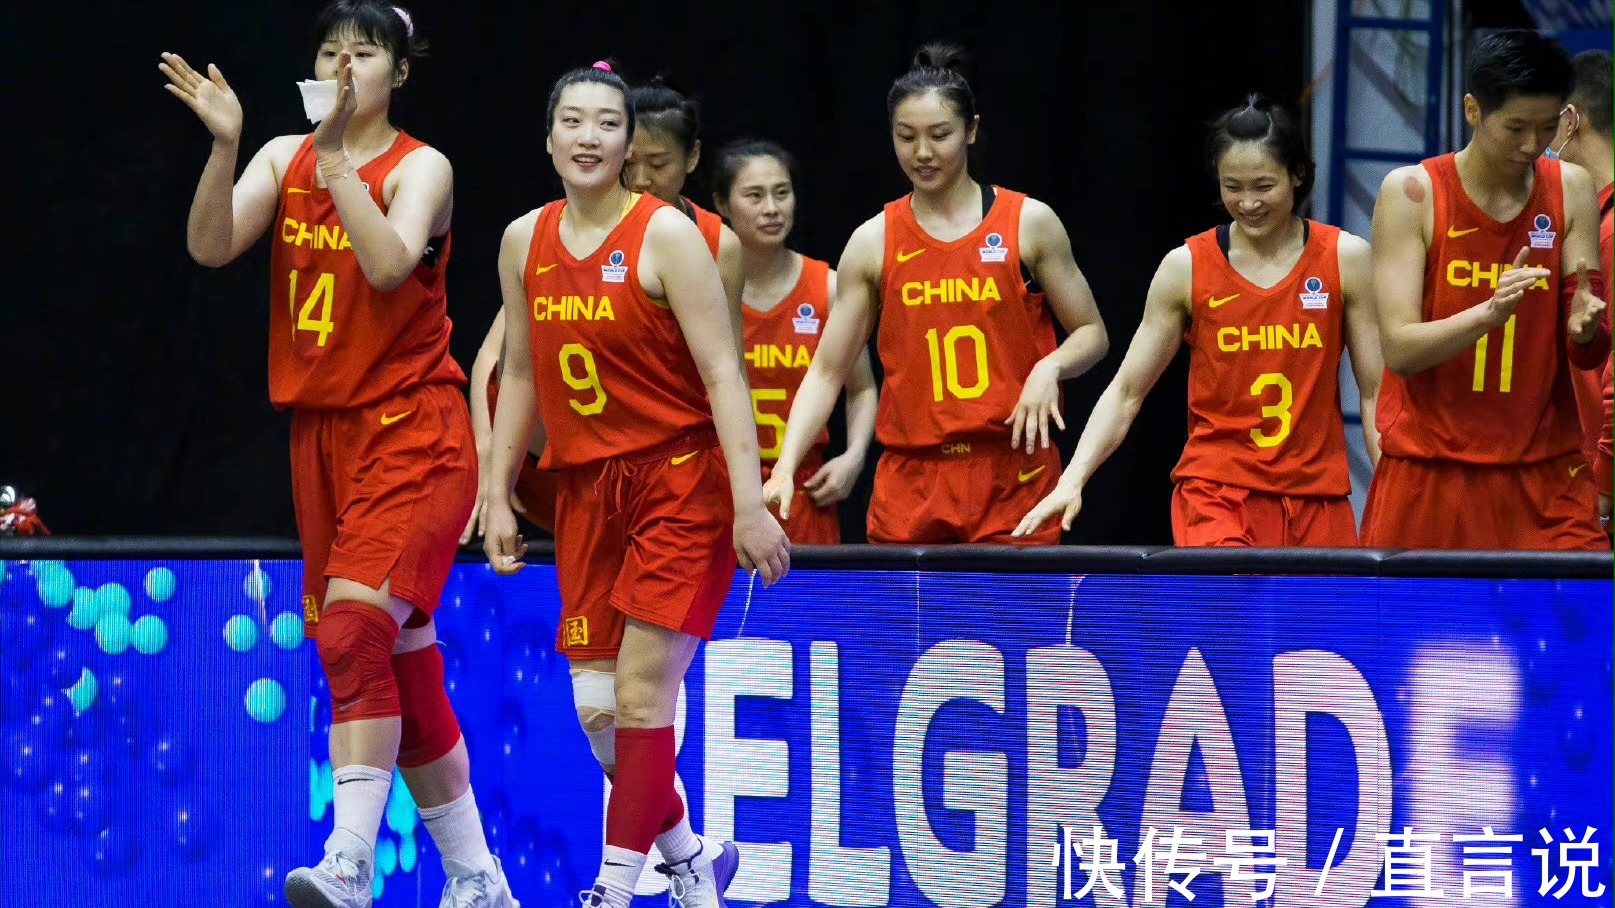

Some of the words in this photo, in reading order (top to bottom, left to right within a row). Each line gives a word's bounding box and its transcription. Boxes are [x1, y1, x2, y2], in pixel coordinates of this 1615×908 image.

[288, 269, 335, 347] 14
[534, 296, 615, 321] CHINA
[902, 277, 1001, 306] CHINA
[744, 344, 812, 368] HINA
[925, 325, 989, 403] 10
[1217, 323, 1323, 352] CHINA
[1472, 314, 1516, 393] 11
[559, 343, 607, 416] 9
[1250, 373, 1293, 448] 3
[750, 388, 787, 459] 5
[941, 443, 971, 455] CHN
